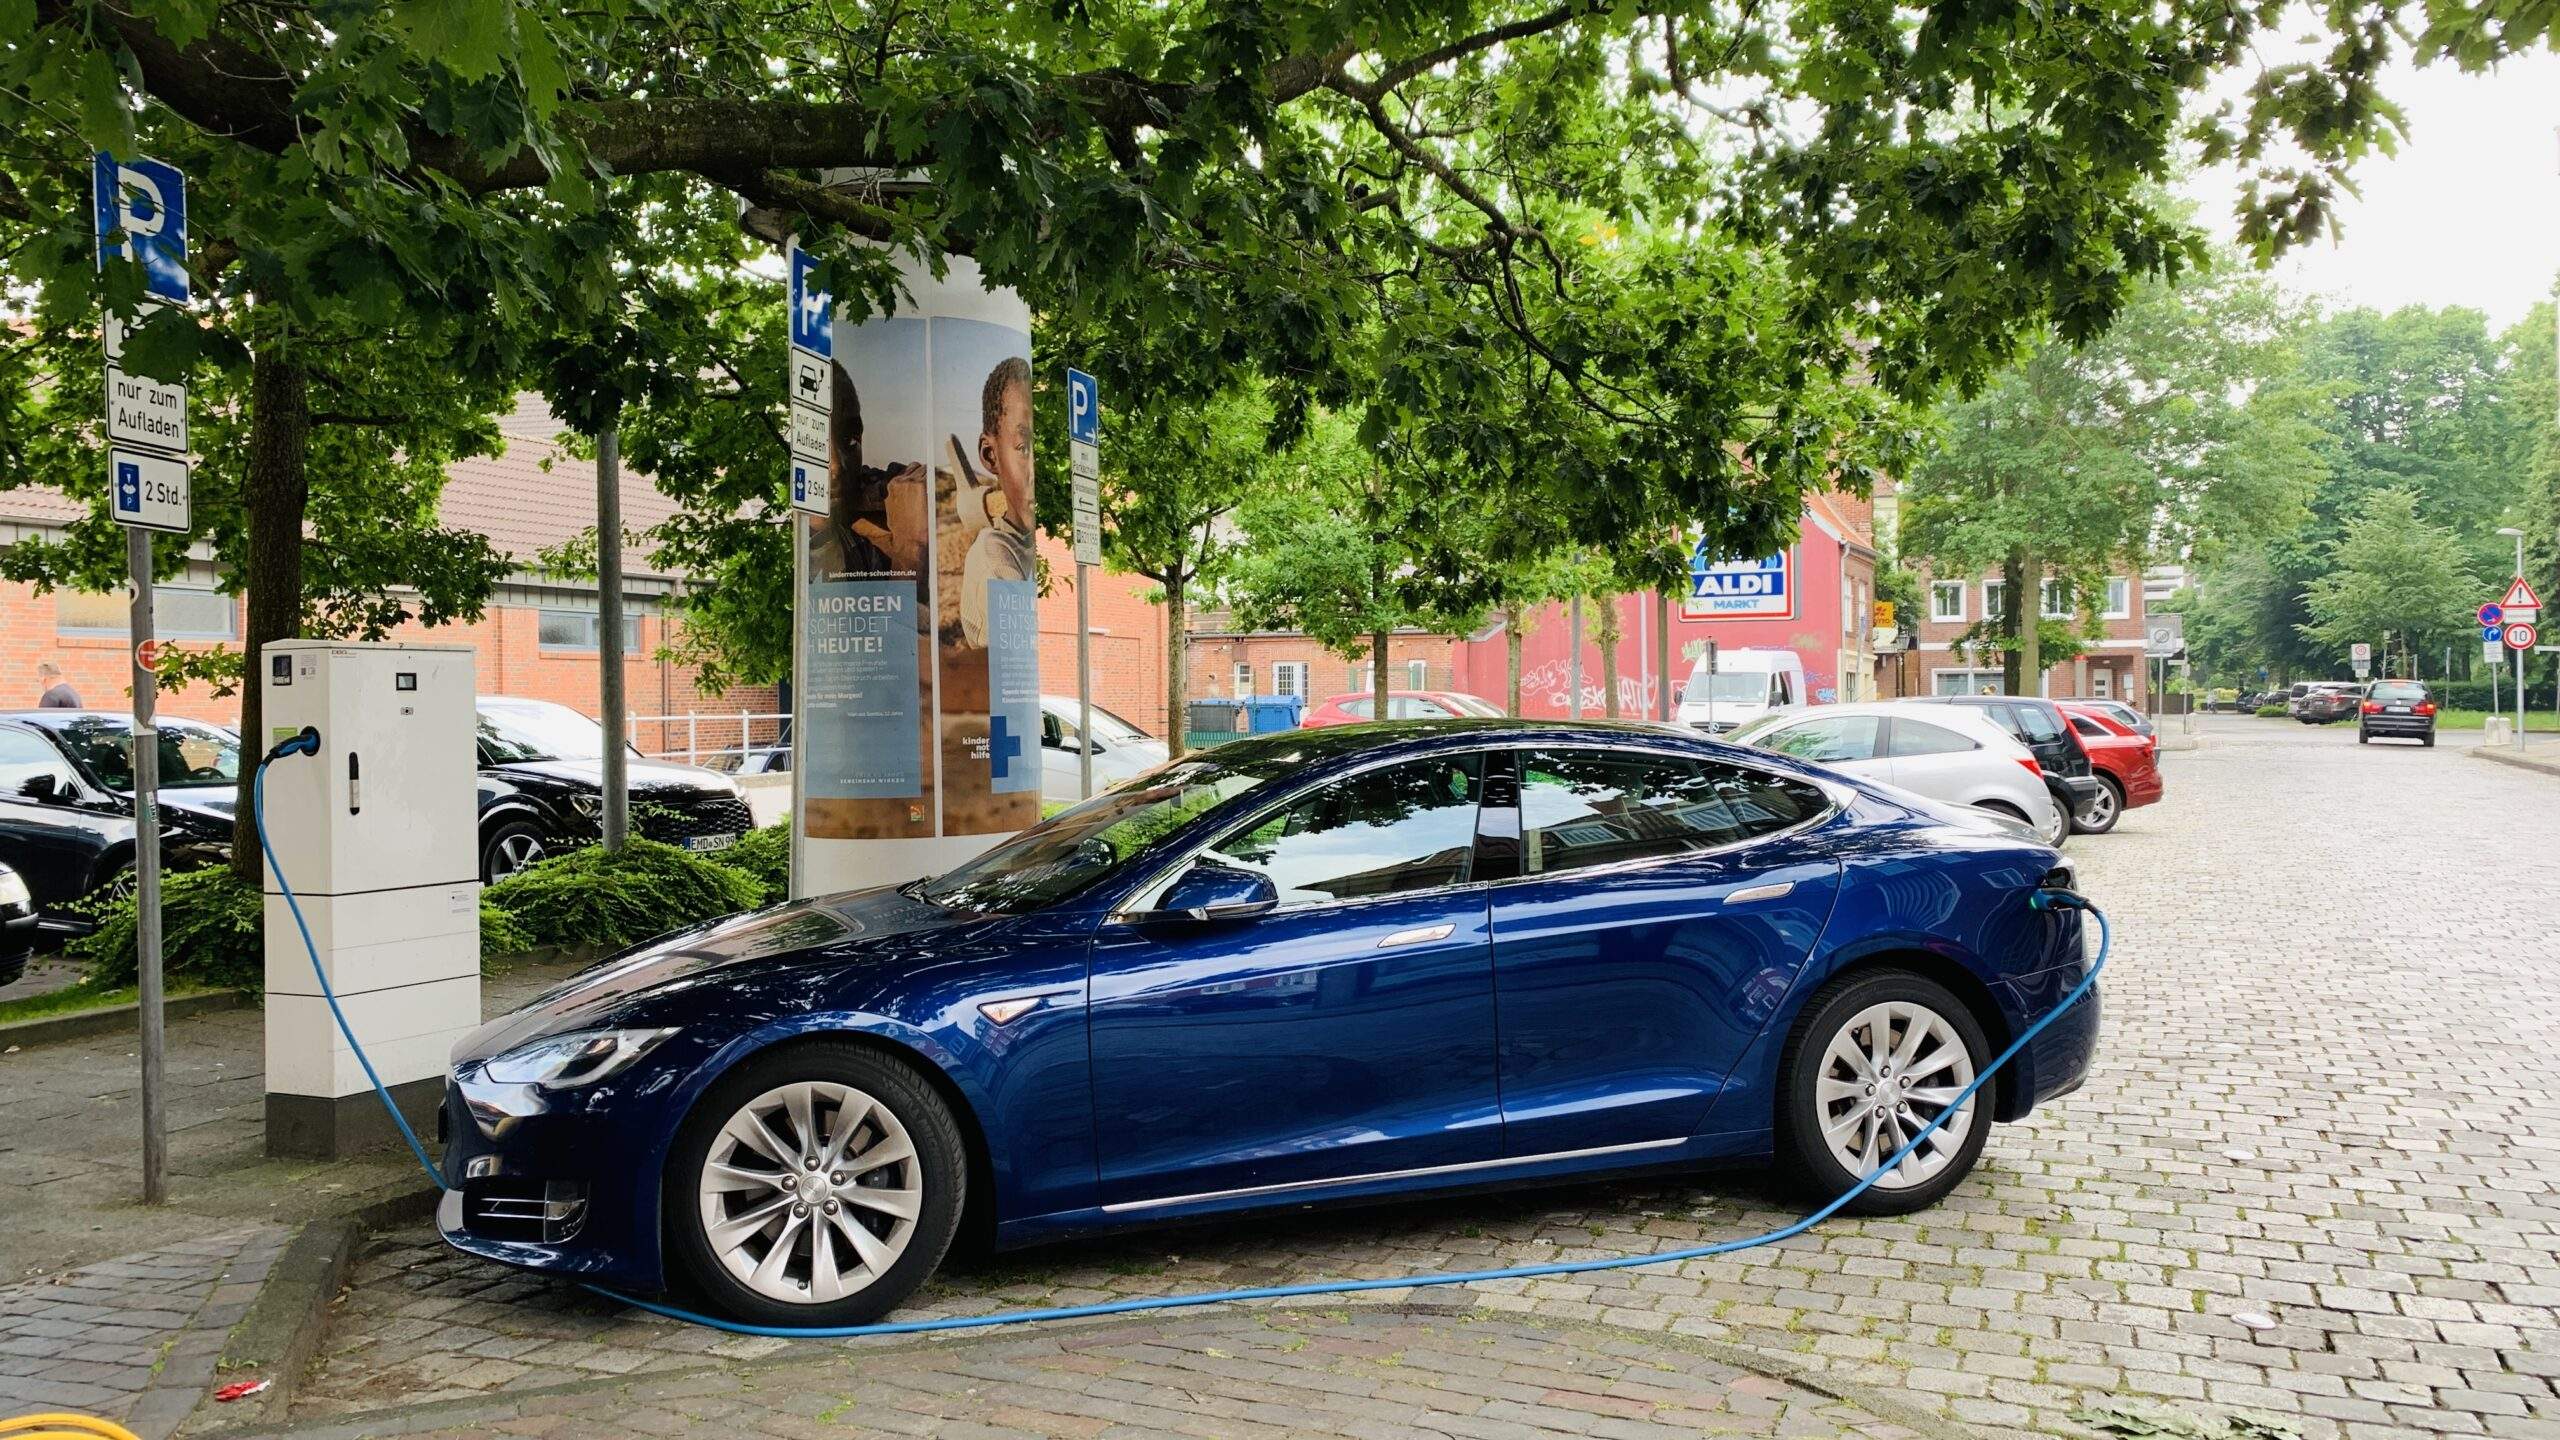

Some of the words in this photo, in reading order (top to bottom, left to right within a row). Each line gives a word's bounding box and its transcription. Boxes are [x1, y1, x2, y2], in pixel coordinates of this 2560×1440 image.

[117, 165, 166, 264] P
[118, 381, 142, 400] nur
[149, 389, 177, 410] zum
[1072, 380, 1088, 434] P
[118, 407, 179, 438] Aufladen
[797, 413, 809, 425] nur
[811, 418, 826, 433] zum
[796, 430, 827, 453] Aufladen
[145, 480, 153, 502] 2
[157, 482, 182, 506] Std.
[807, 480, 812, 495] 2
[1696, 574, 1772, 596] ALDI
[818, 595, 902, 614] MORGEN
[1713, 599, 1760, 609] MARKT
[817, 636, 883, 654] HEUTE!
[2512, 630, 2528, 642] 10
[962, 736, 990, 745] kinder
[970, 751, 990, 760] hilfe
[691, 838, 708, 851] EMD
[714, 836, 725, 849] SN
